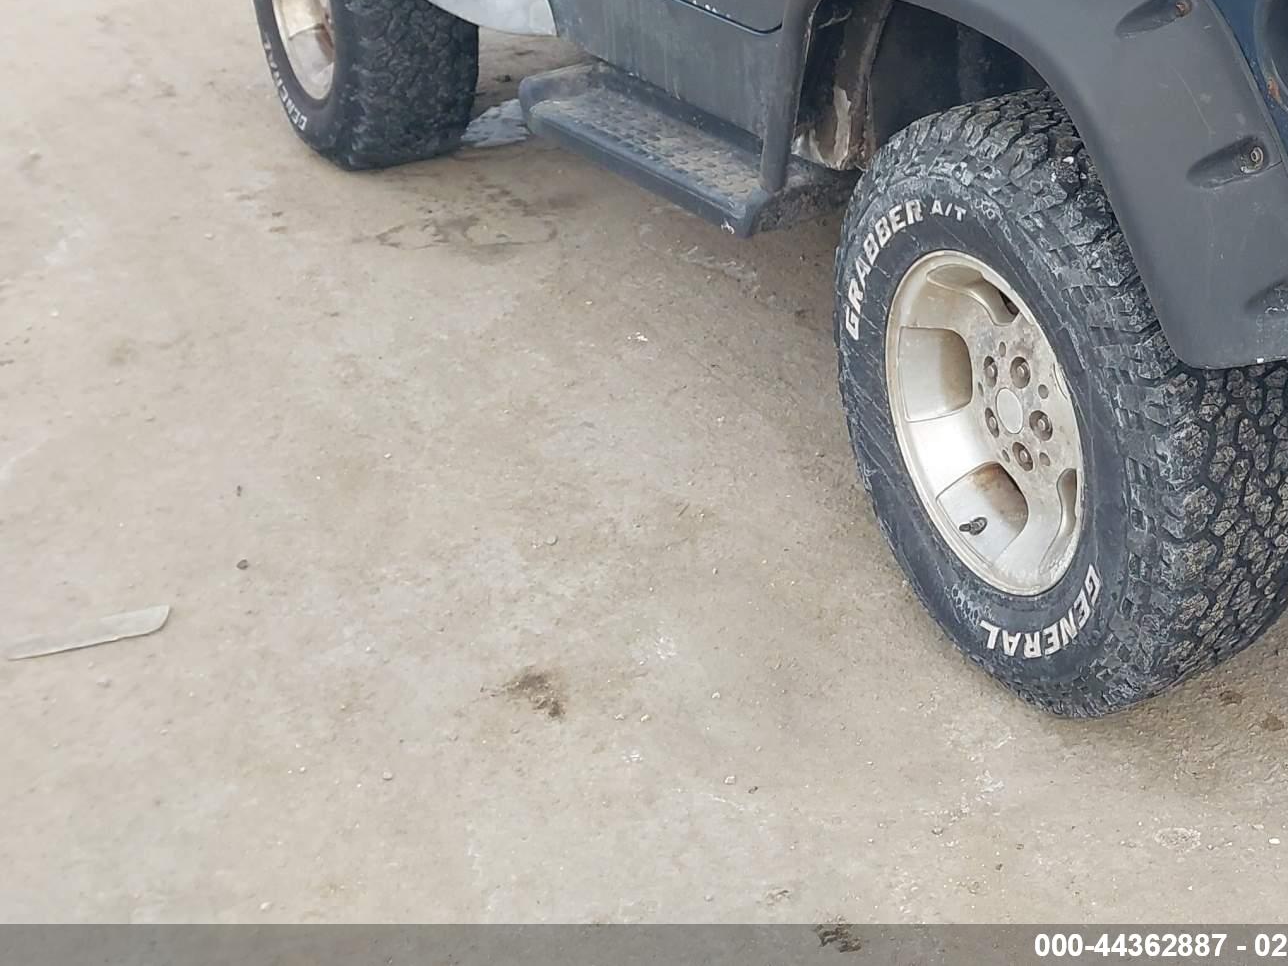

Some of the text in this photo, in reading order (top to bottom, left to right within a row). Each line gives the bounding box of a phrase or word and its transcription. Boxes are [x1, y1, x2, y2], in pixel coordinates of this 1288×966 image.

[845, 198, 967, 341] GRABBER A/T
[979, 563, 1101, 659] GENERAL
